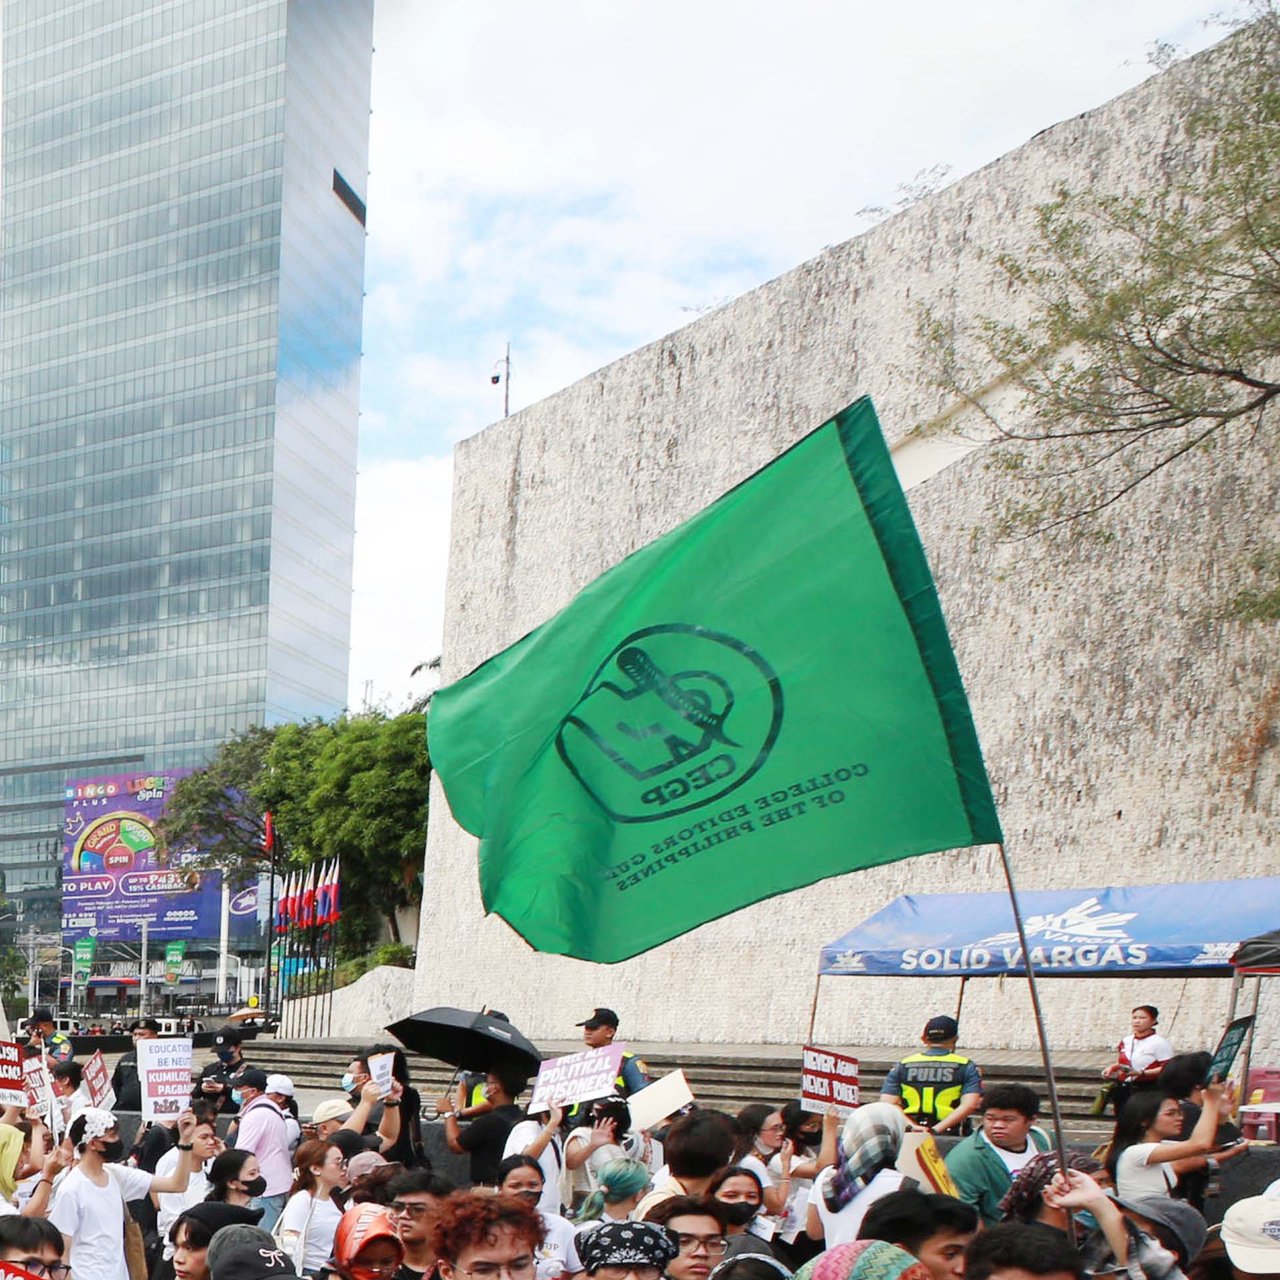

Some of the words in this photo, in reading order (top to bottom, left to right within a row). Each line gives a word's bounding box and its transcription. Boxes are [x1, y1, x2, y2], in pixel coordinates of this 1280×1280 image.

[65, 784, 117, 798] BINGO
[72, 798, 108, 808] PLUS
[136, 788, 164, 802] Spin
[108, 855, 129, 864] SPIN
[79, 880, 113, 892] PLAY
[1042, 930, 1136, 945] VARGAS
[899, 947, 992, 971] SOLID
[1003, 943, 1150, 970] VARGAS
[157, 1057, 171, 1068] BE
[556, 1054, 585, 1067] FREE
[585, 1048, 606, 1059] ALL
[539, 1056, 612, 1084] POLITICAL
[906, 1067, 955, 1083] PULIS
[536, 1072, 617, 1103] PRISONERS
